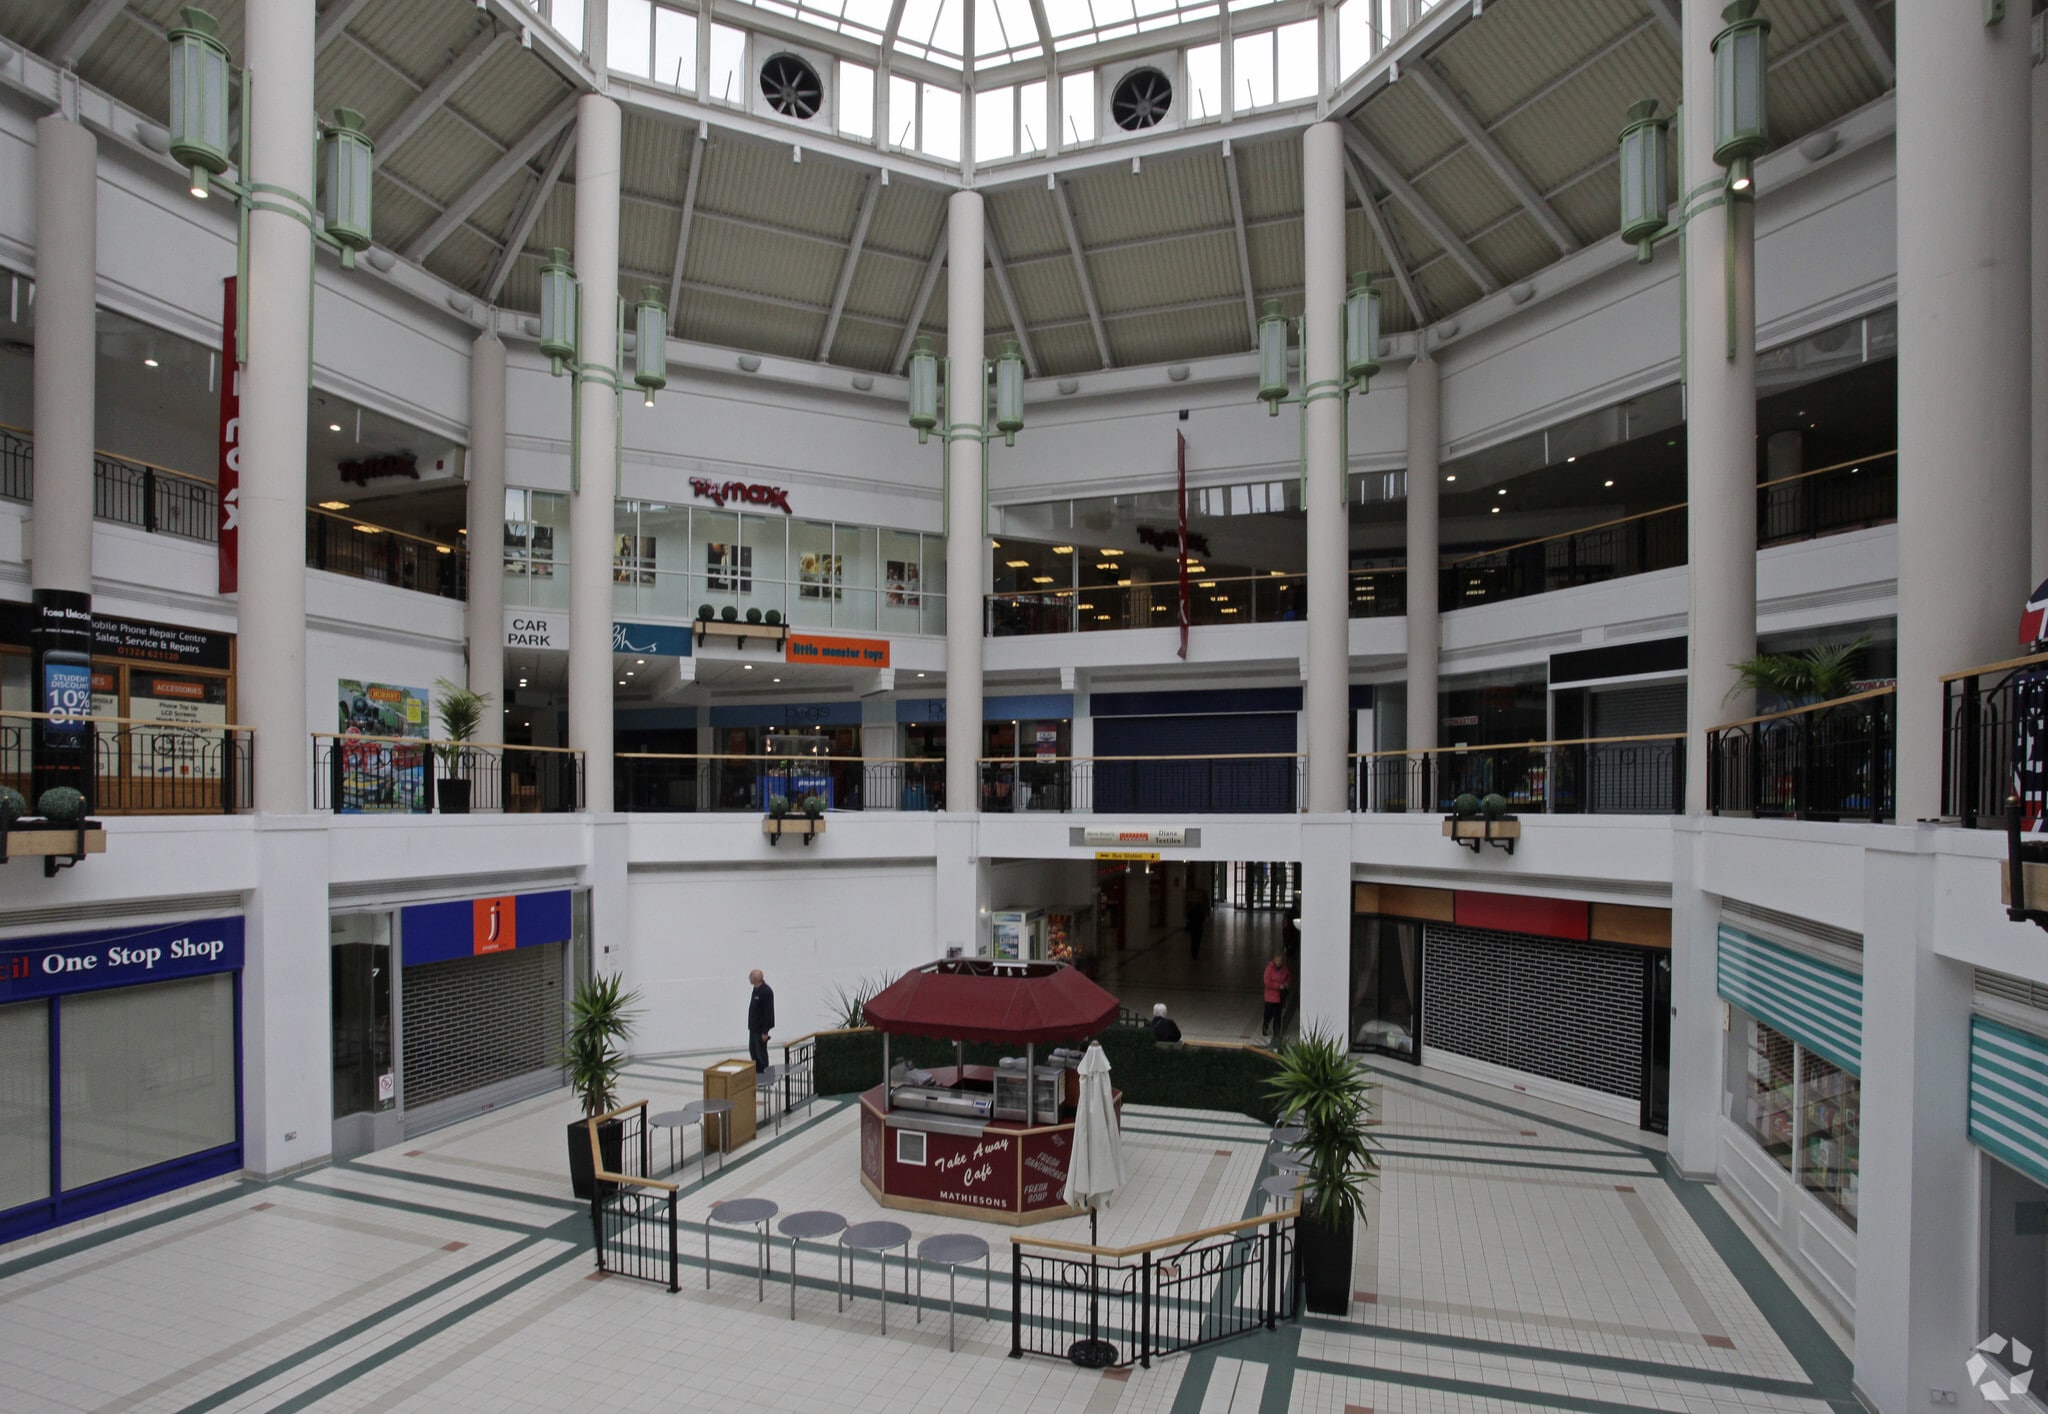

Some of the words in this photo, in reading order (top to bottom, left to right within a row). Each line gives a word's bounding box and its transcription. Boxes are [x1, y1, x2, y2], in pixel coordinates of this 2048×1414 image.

[120, 623, 147, 635] Phone
[149, 627, 177, 640] Repair
[179, 631, 207, 643] Centre
[512, 618, 547, 632] CAR
[95, 632, 123, 645] Sales,
[126, 635, 158, 648] Service
[160, 641, 167, 649] &
[170, 641, 200, 654] Repairs
[507, 633, 550, 647] PARK
[793, 642, 818, 655] little
[822, 647, 860, 659] monster
[864, 648, 884, 663] toys
[51, 681, 89, 690] DISCOUNT
[53, 673, 89, 683] STUDENT
[49, 689, 90, 709] 10%
[156, 683, 202, 695] ACCESSORIES
[48, 706, 90, 726] OFF
[42, 953, 97, 974] One
[108, 946, 161, 969] Stop
[170, 937, 224, 961] Shop
[934, 1152, 967, 1173] Take
[973, 1139, 1009, 1161] Away
[963, 1162, 993, 1187] Café
[940, 1190, 1007, 1208] MATHIESONS
